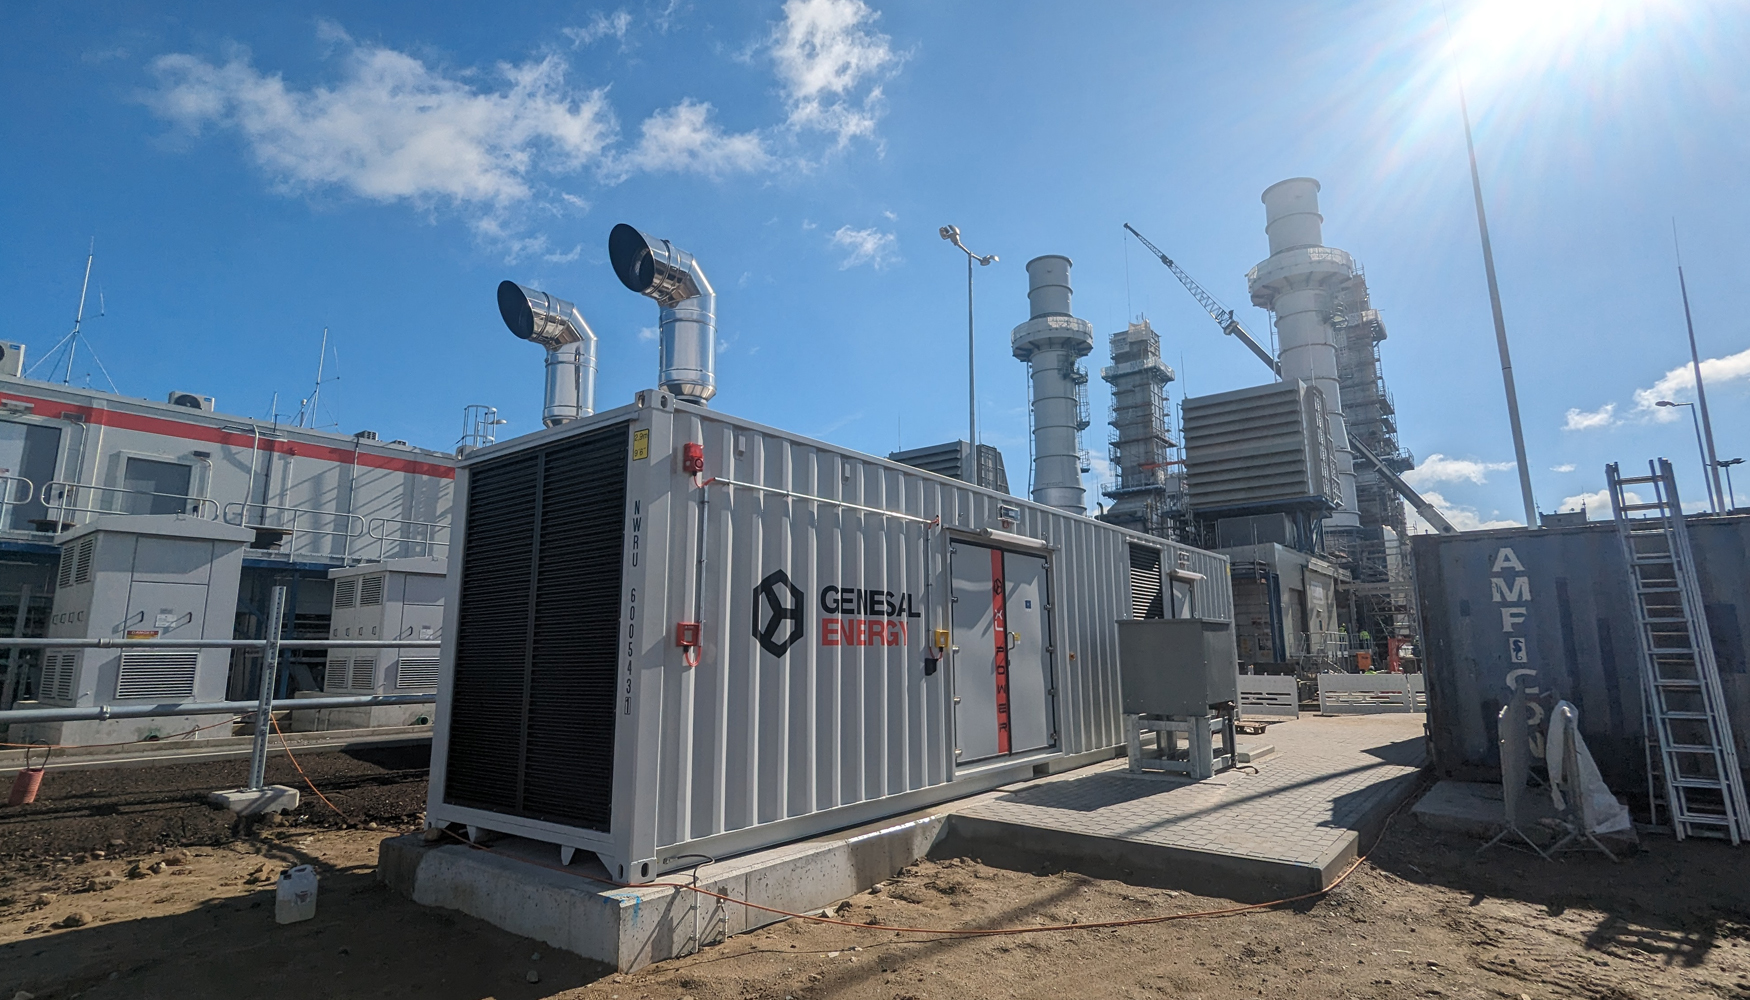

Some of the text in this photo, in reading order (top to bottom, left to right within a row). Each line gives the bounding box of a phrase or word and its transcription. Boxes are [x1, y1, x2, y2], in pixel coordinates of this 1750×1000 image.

[632, 500, 642, 567] NWRU
[820, 585, 921, 618] GENESAL
[821, 618, 909, 647] ENERGY
[994, 609, 1008, 733] XL POWER
